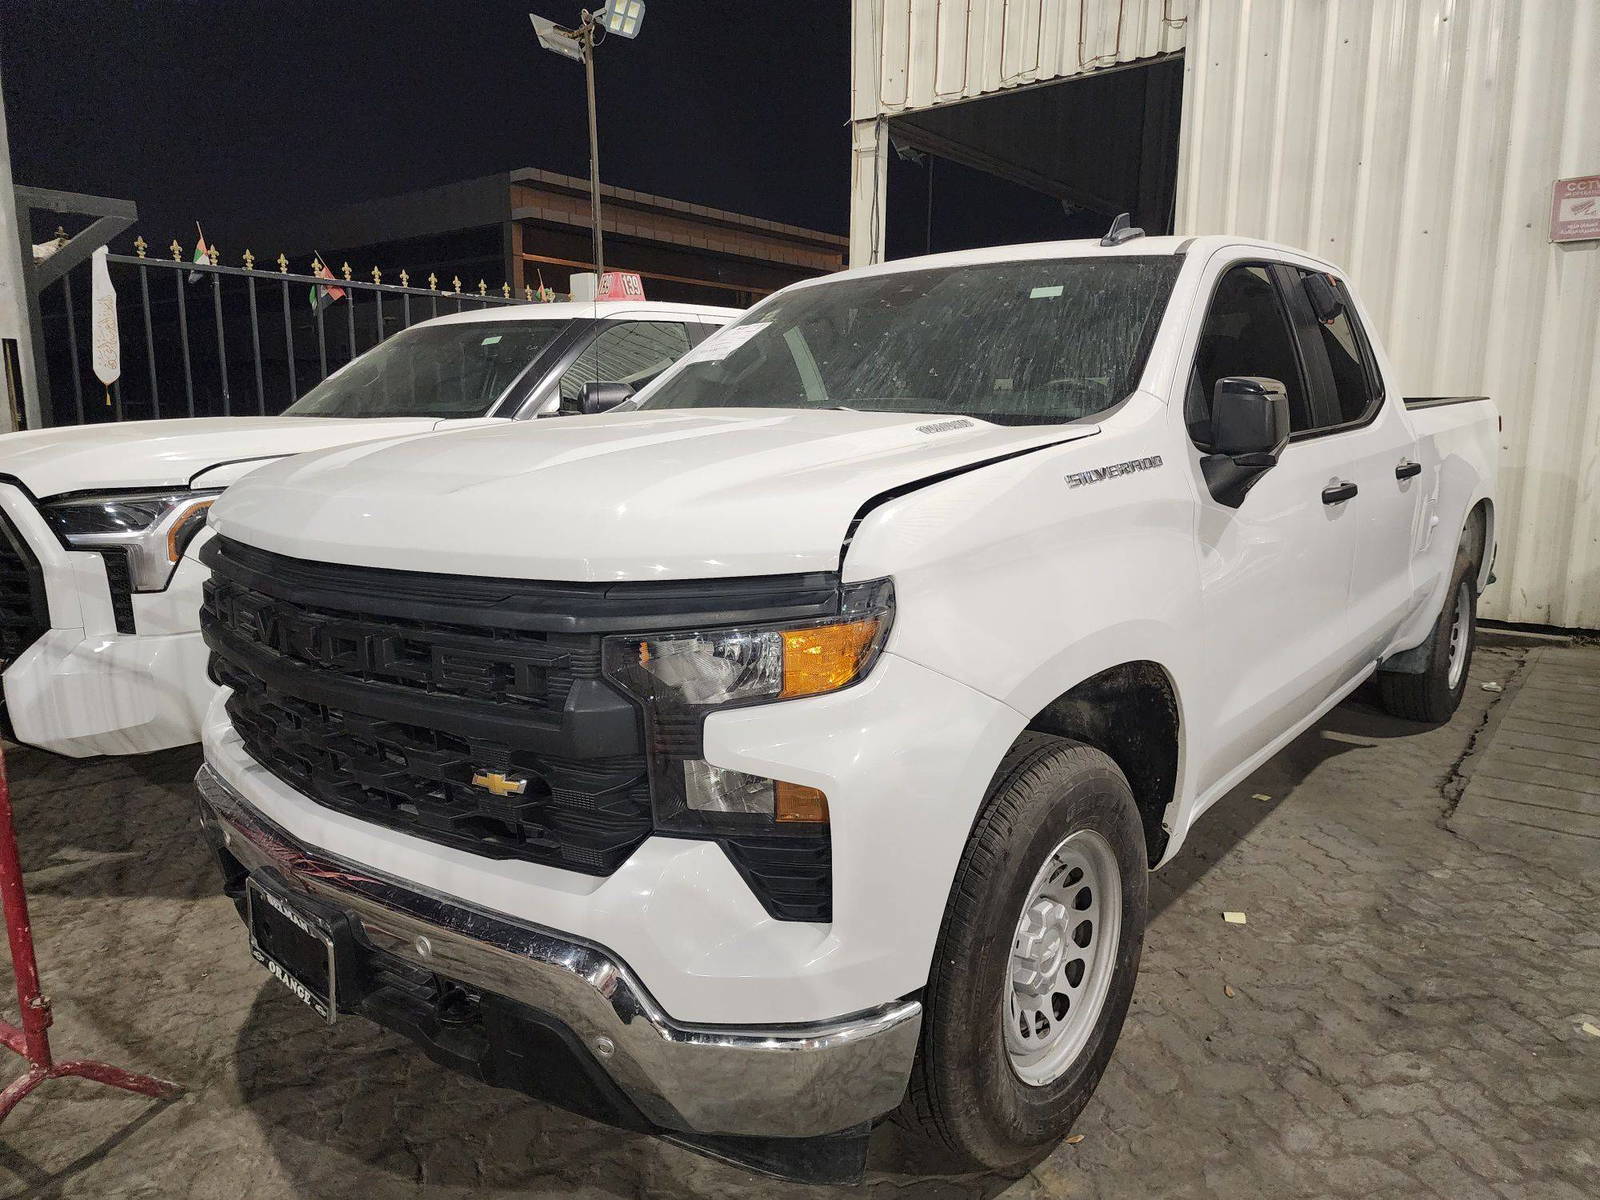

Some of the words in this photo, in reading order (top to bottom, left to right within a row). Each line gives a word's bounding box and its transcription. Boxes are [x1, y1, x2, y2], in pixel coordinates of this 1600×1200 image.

[622, 274, 641, 295] 139
[1064, 455, 1163, 489] SILVERADO
[267, 960, 311, 1005] ORANGE
